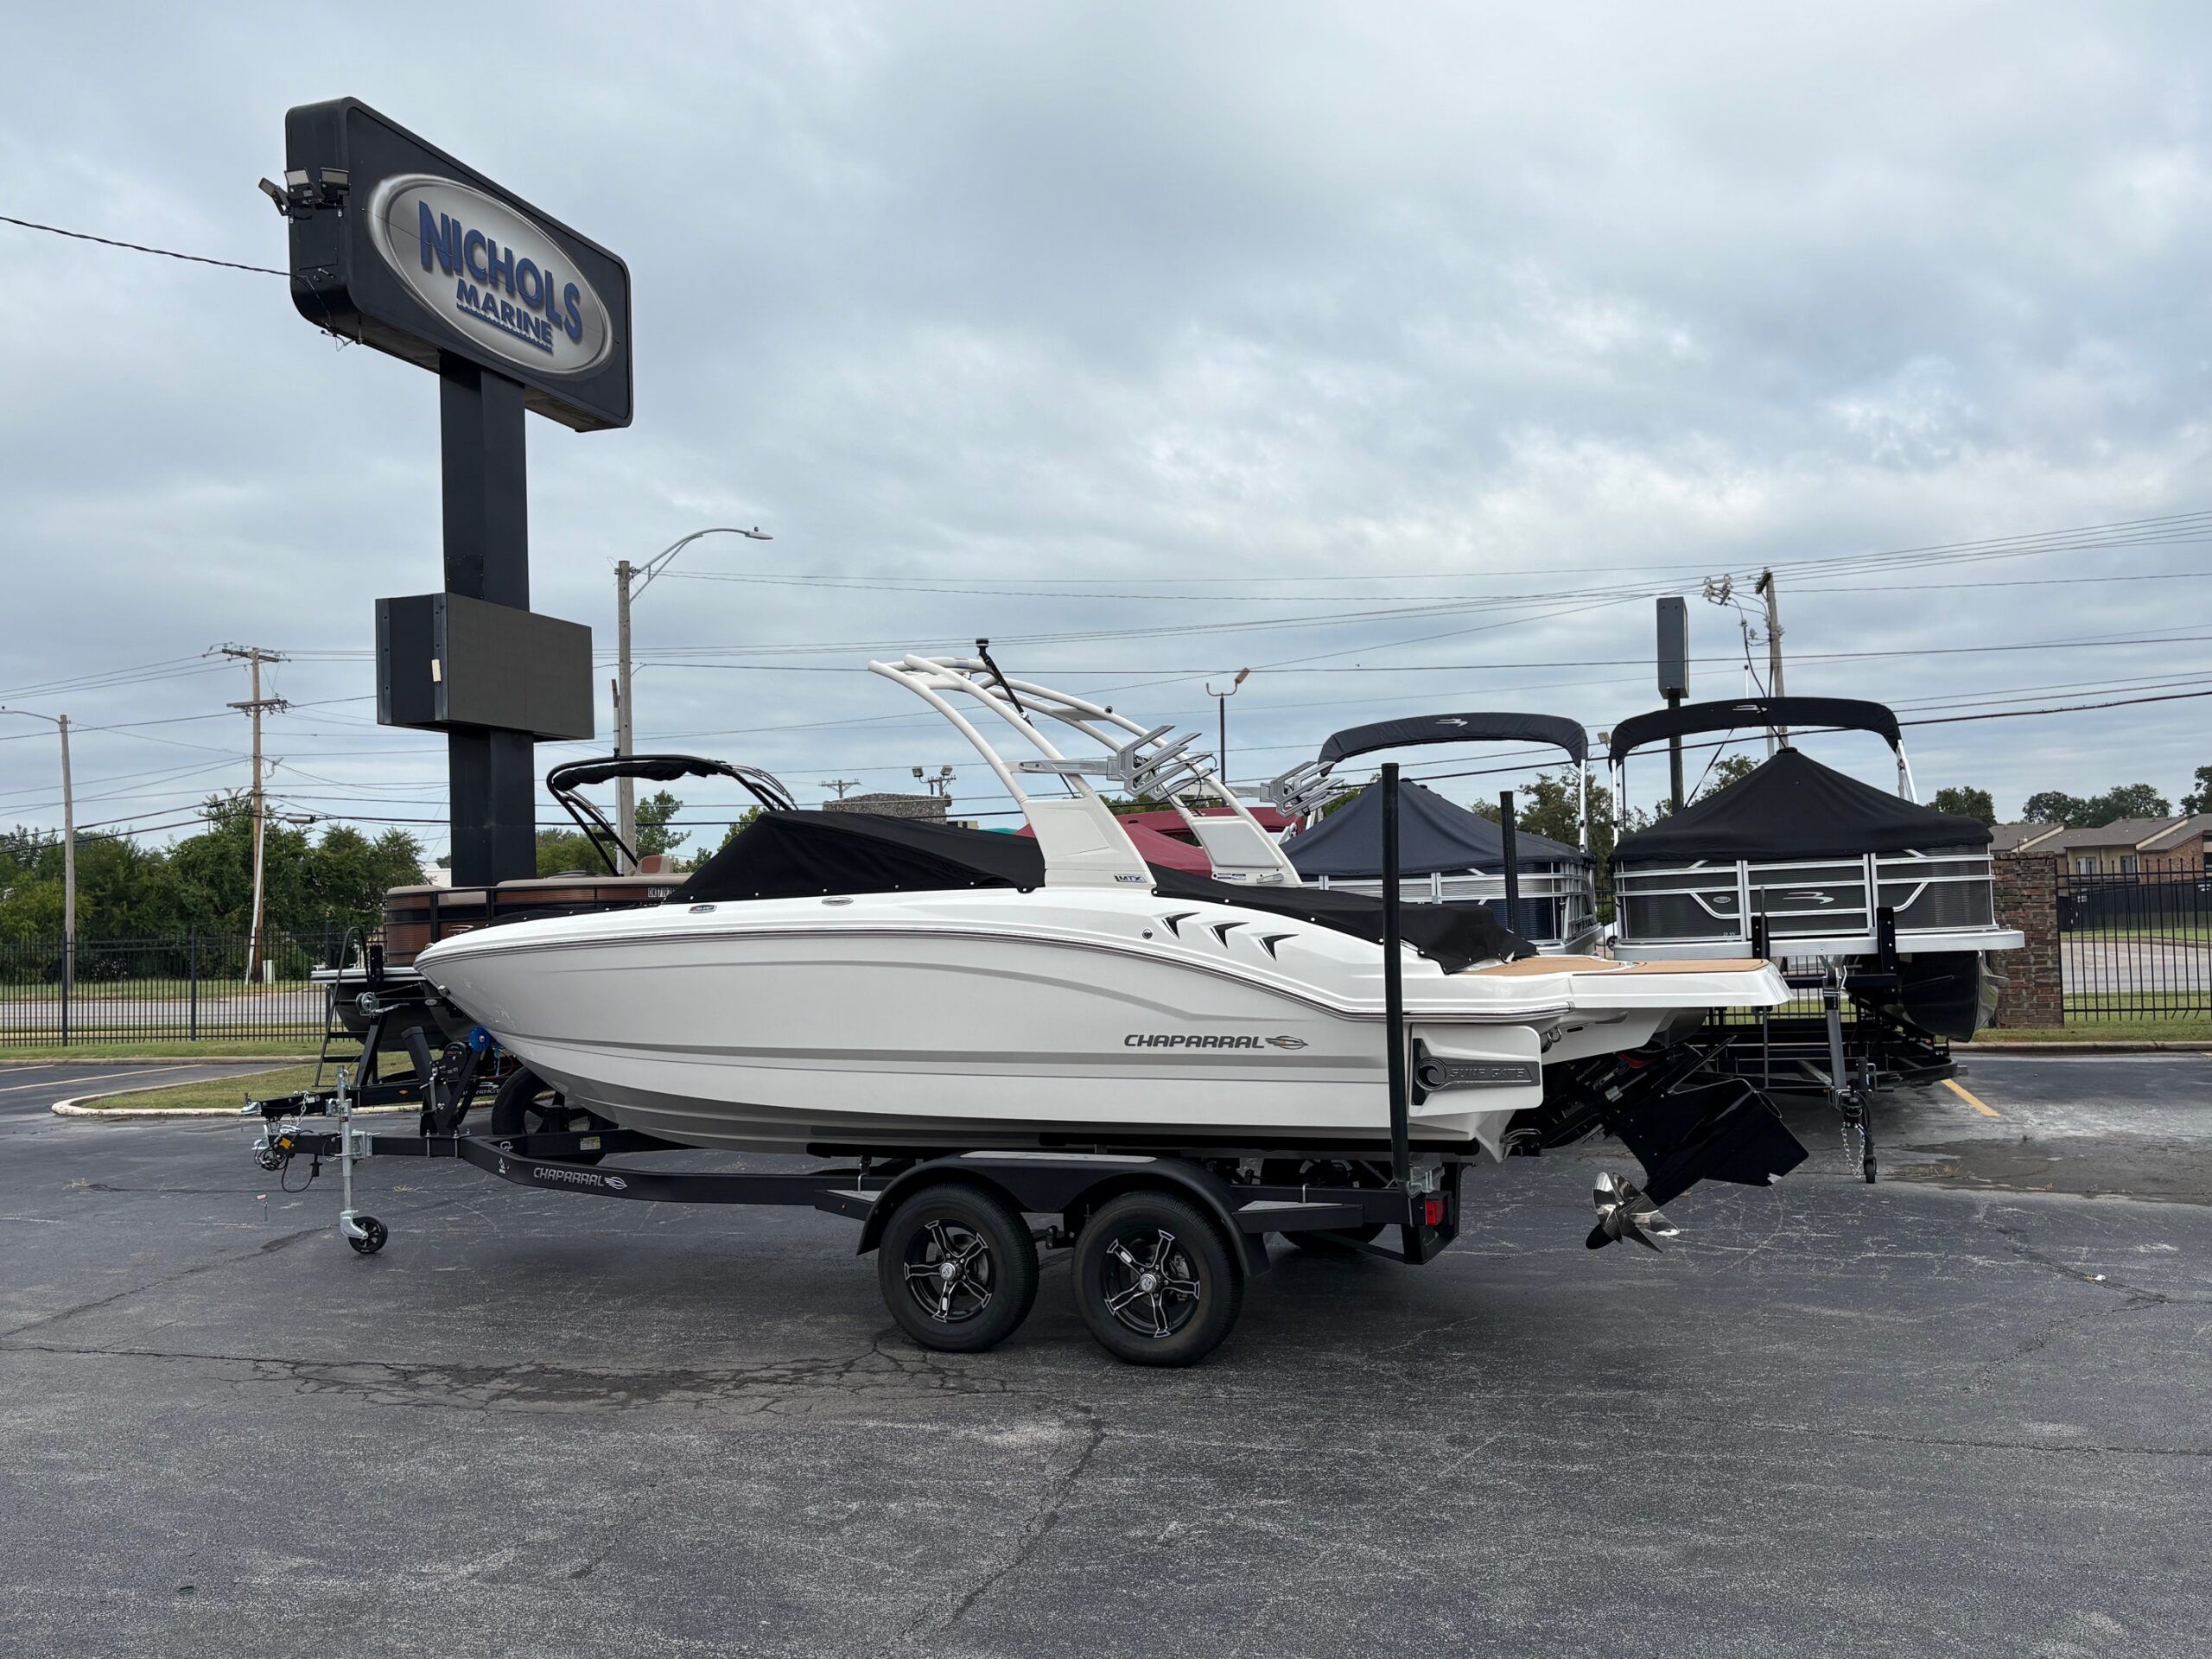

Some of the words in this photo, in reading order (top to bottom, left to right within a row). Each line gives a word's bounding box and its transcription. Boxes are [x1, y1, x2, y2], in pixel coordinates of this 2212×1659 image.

[418, 200, 582, 340] NICHOLS
[456, 278, 552, 343] MARINE
[1124, 1034, 1265, 1049] CHAPARRAL
[1449, 1067, 1485, 1078] SURF
[1491, 1067, 1526, 1078] GATE
[533, 1166, 605, 1187] CHAPARRAL
